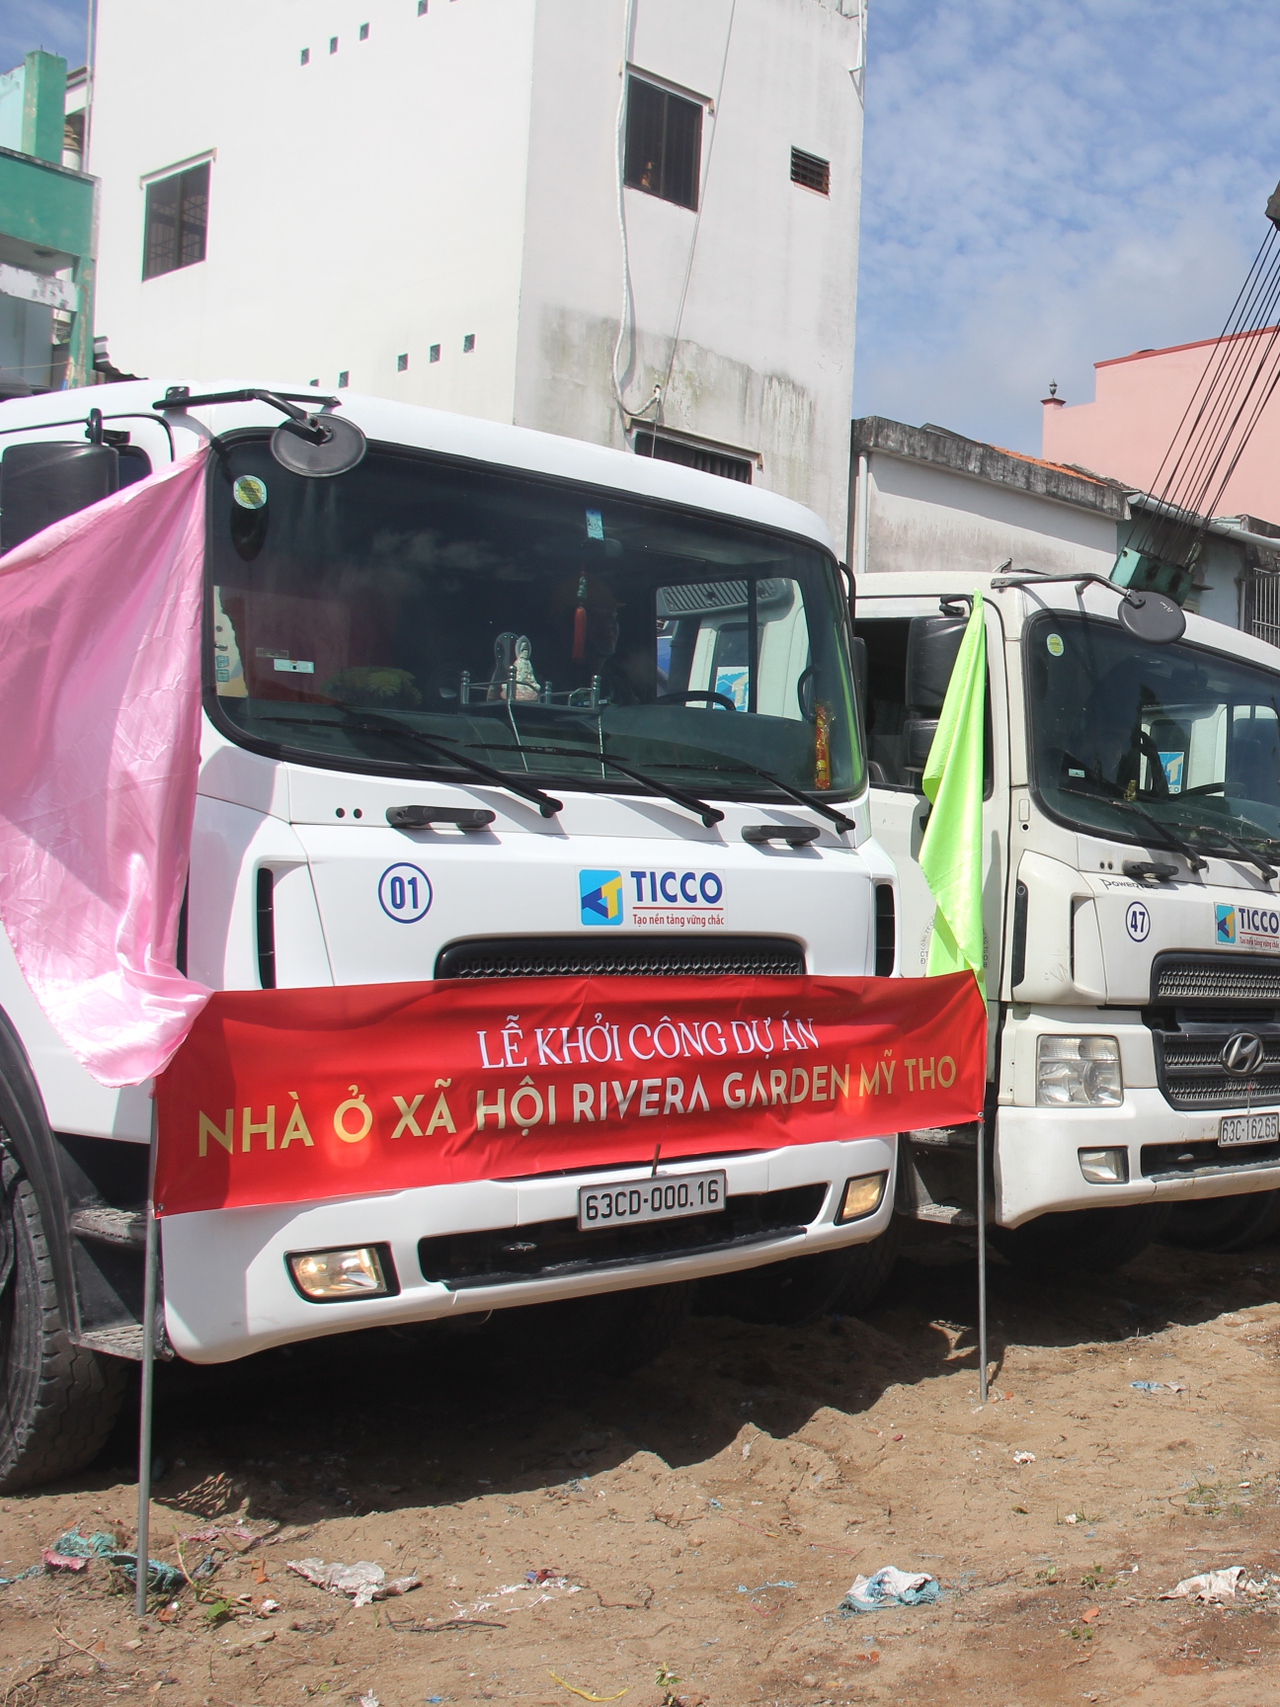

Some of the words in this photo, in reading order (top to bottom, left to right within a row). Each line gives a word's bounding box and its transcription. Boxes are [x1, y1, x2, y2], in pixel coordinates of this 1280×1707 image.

[390, 875, 420, 910] 01
[630, 871, 724, 905] TICCO
[633, 914, 648, 928] Tạo
[666, 913, 684, 927] tảng
[686, 914, 706, 928] vững
[707, 914, 724, 926] chắc
[1130, 910, 1146, 933] 47
[1238, 908, 1280, 934] TICCO
[477, 1014, 527, 1069] LỄ
[536, 1012, 623, 1066] KHỞI
[628, 1015, 727, 1061] CÔNG
[730, 1016, 776, 1059] DỰ
[782, 1010, 820, 1051] ÁN
[199, 1091, 315, 1157] NHÀ
[333, 1084, 373, 1143] Ở
[390, 1078, 457, 1139] XÃ
[476, 1075, 556, 1136] HỘI
[572, 1074, 711, 1123] RIVERA
[723, 1063, 850, 1109] GARDEN
[858, 1048, 897, 1098] MỸ
[904, 1055, 957, 1093] THO
